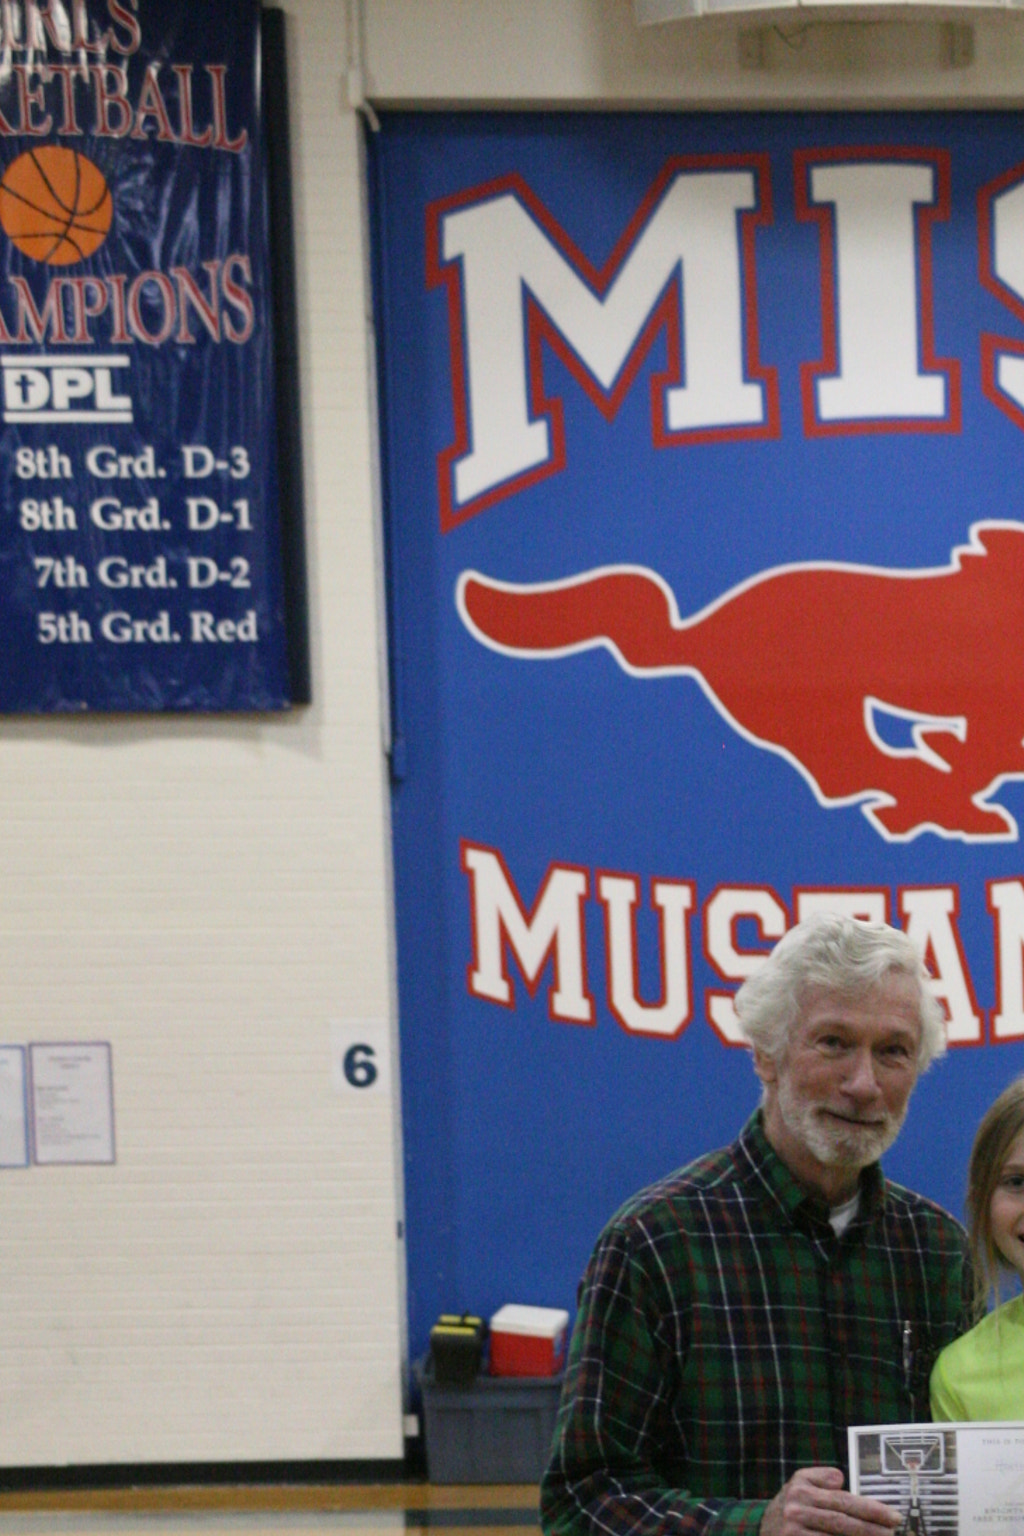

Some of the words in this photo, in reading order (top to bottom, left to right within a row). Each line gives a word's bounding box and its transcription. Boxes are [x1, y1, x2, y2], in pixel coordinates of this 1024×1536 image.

[0, 63, 248, 153] ETBALL
[3, 367, 133, 411] DPL
[16, 445, 73, 479] 8th
[86, 444, 167, 479] Grd.
[182, 445, 250, 479] D-3
[20, 497, 78, 531] 8th
[90, 497, 171, 531] Grd.
[186, 497, 253, 531] D-1
[34, 556, 90, 588] 7th
[97, 556, 178, 588] Grd.
[187, 556, 251, 588] D-2
[38, 611, 93, 644] 5th
[101, 611, 181, 643] Grd.
[190, 610, 258, 642] Red
[343, 1043, 378, 1089] 6
